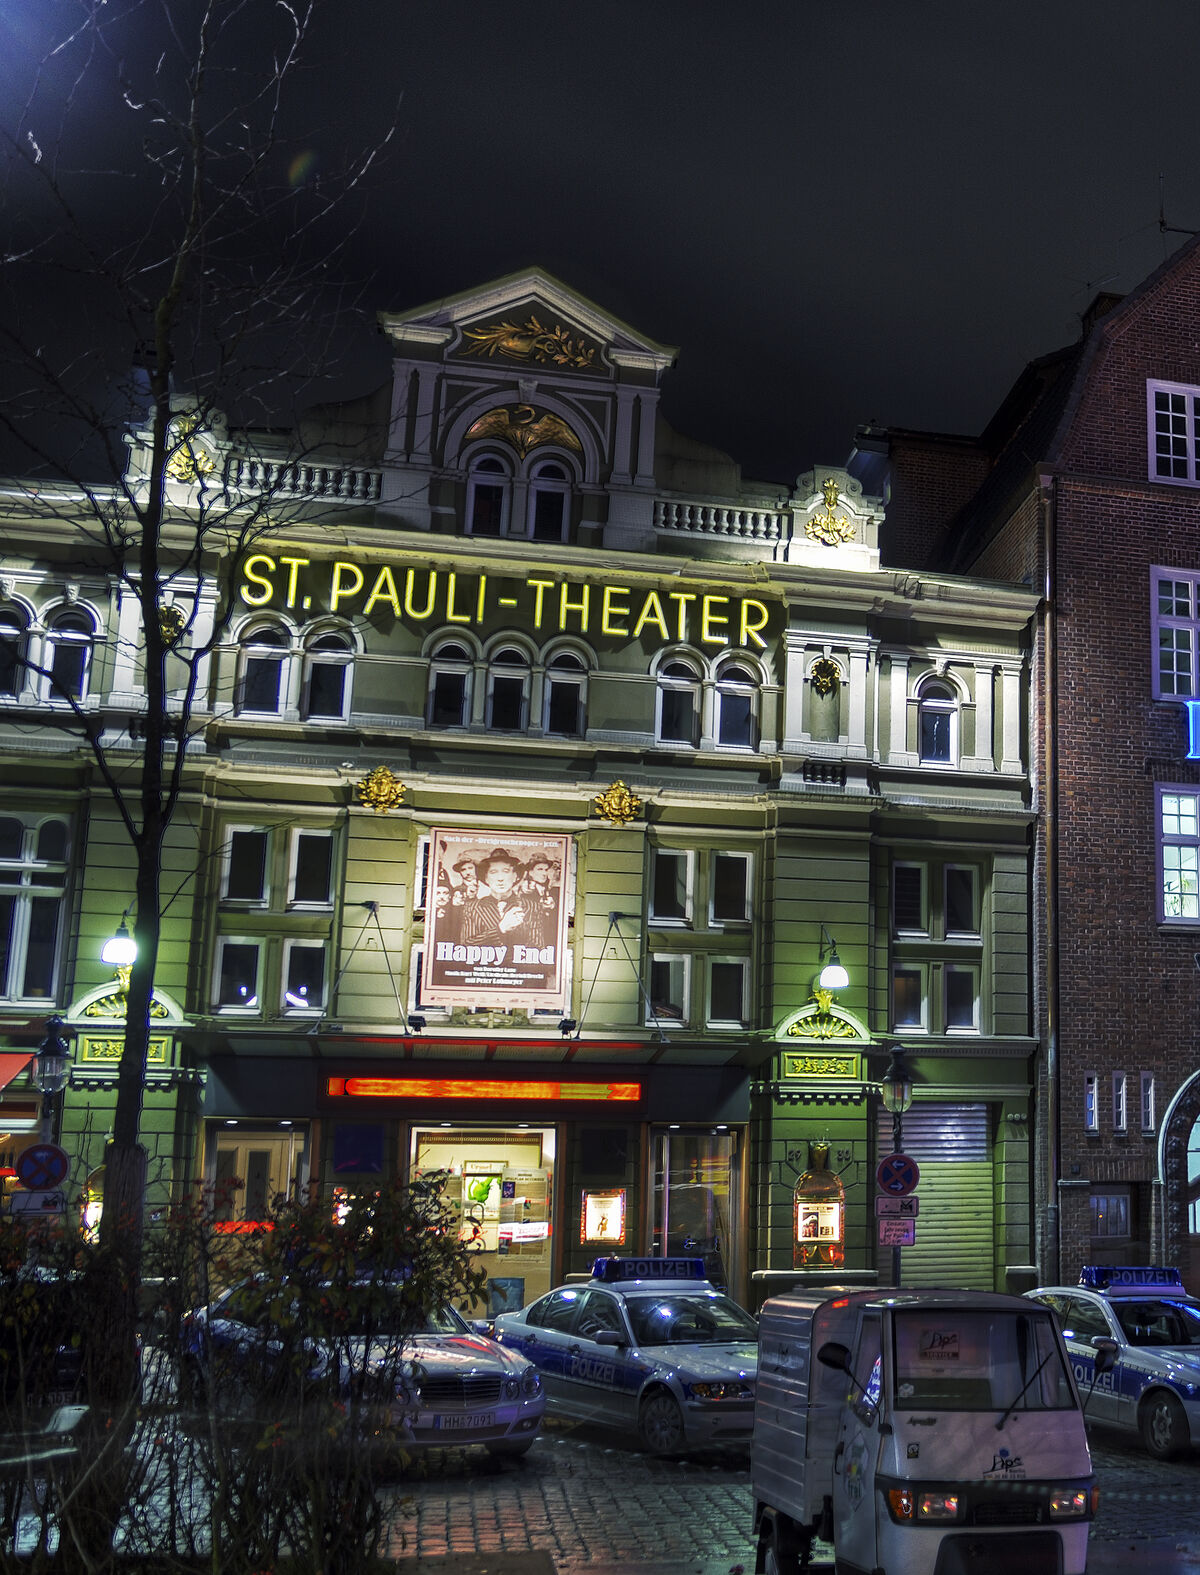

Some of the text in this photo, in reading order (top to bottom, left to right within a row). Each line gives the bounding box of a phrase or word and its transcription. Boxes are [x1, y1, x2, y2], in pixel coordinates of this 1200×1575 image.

[240, 554, 312, 609] ST.
[436, 942, 555, 966] Happy End
[624, 1261, 691, 1277] POLIZEI
[1112, 1270, 1169, 1285] POLIZEI
[570, 1358, 616, 1384] POLIZEI
[1071, 1361, 1115, 1391] OLIZEI
